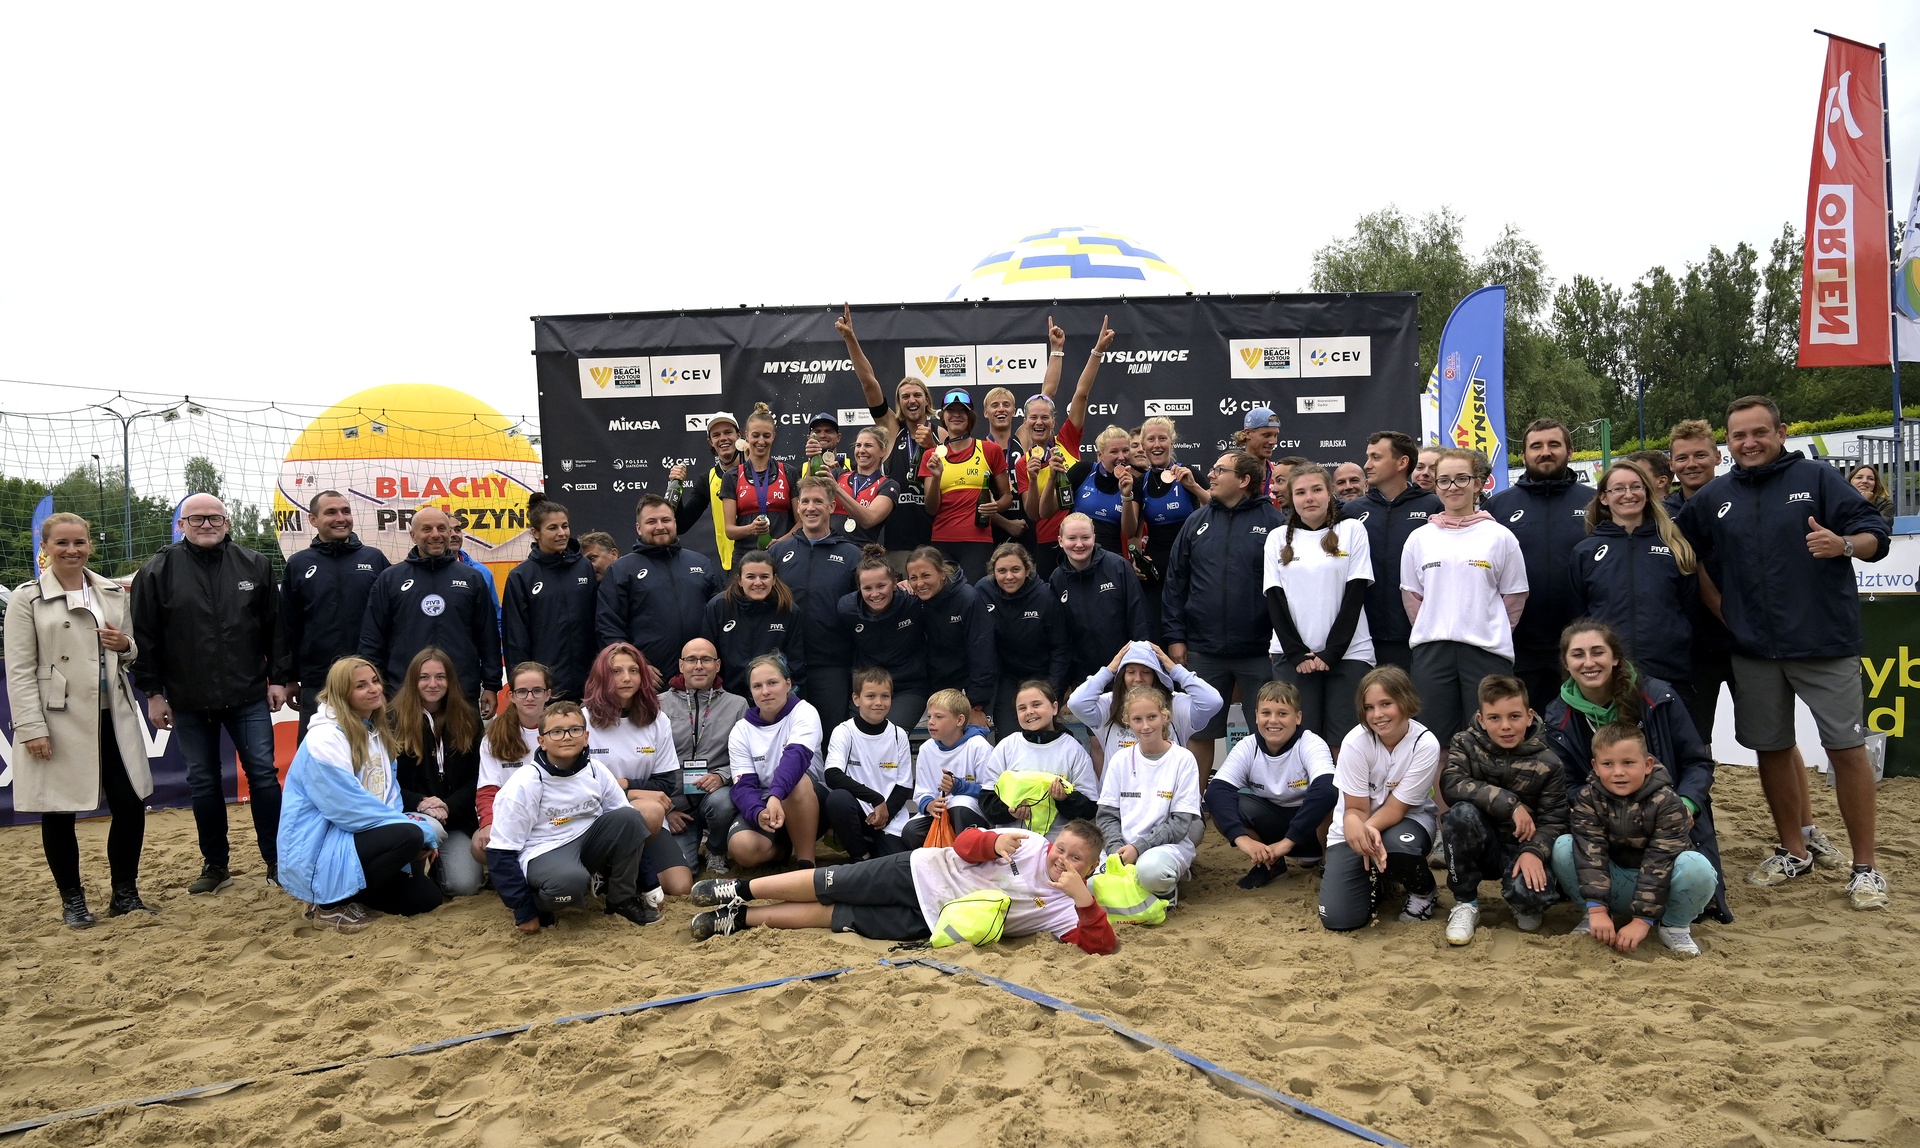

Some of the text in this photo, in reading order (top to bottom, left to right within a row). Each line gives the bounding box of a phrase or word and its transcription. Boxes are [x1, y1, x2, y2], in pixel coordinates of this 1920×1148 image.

[1331, 351, 1360, 362] CEV
[763, 359, 855, 373] MYSLOWIC
[1007, 359, 1037, 369] CEV
[1127, 363, 1152, 374] POLAND
[681, 369, 711, 380] CEV
[801, 373, 826, 384] POLAND
[1087, 404, 1118, 415] CEV
[1241, 400, 1271, 412] CEV
[780, 413, 811, 425] CEV
[1471, 379, 1487, 453] ZYŃSKI
[1279, 440, 1301, 448] CEV
[676, 458, 697, 466] CEV
[975, 456, 981, 465] 2
[966, 468, 979, 476] UKR
[376, 476, 508, 498] BLACHY
[779, 479, 785, 489] 2
[773, 491, 785, 500] POL
[870, 486, 876, 496] 1
[1174, 485, 1179, 497] 1
[1789, 492, 1812, 500] FIVB
[900, 494, 926, 504] ORLEN
[1167, 502, 1180, 510] NED
[376, 503, 531, 531] PRSZYŃ
[830, 554, 844, 562] FIVB
[1100, 582, 1114, 590] FIVB
[898, 619, 912, 628] FIVB
[1860, 646, 1920, 699] yb
[545, 804, 580, 817] Sport
